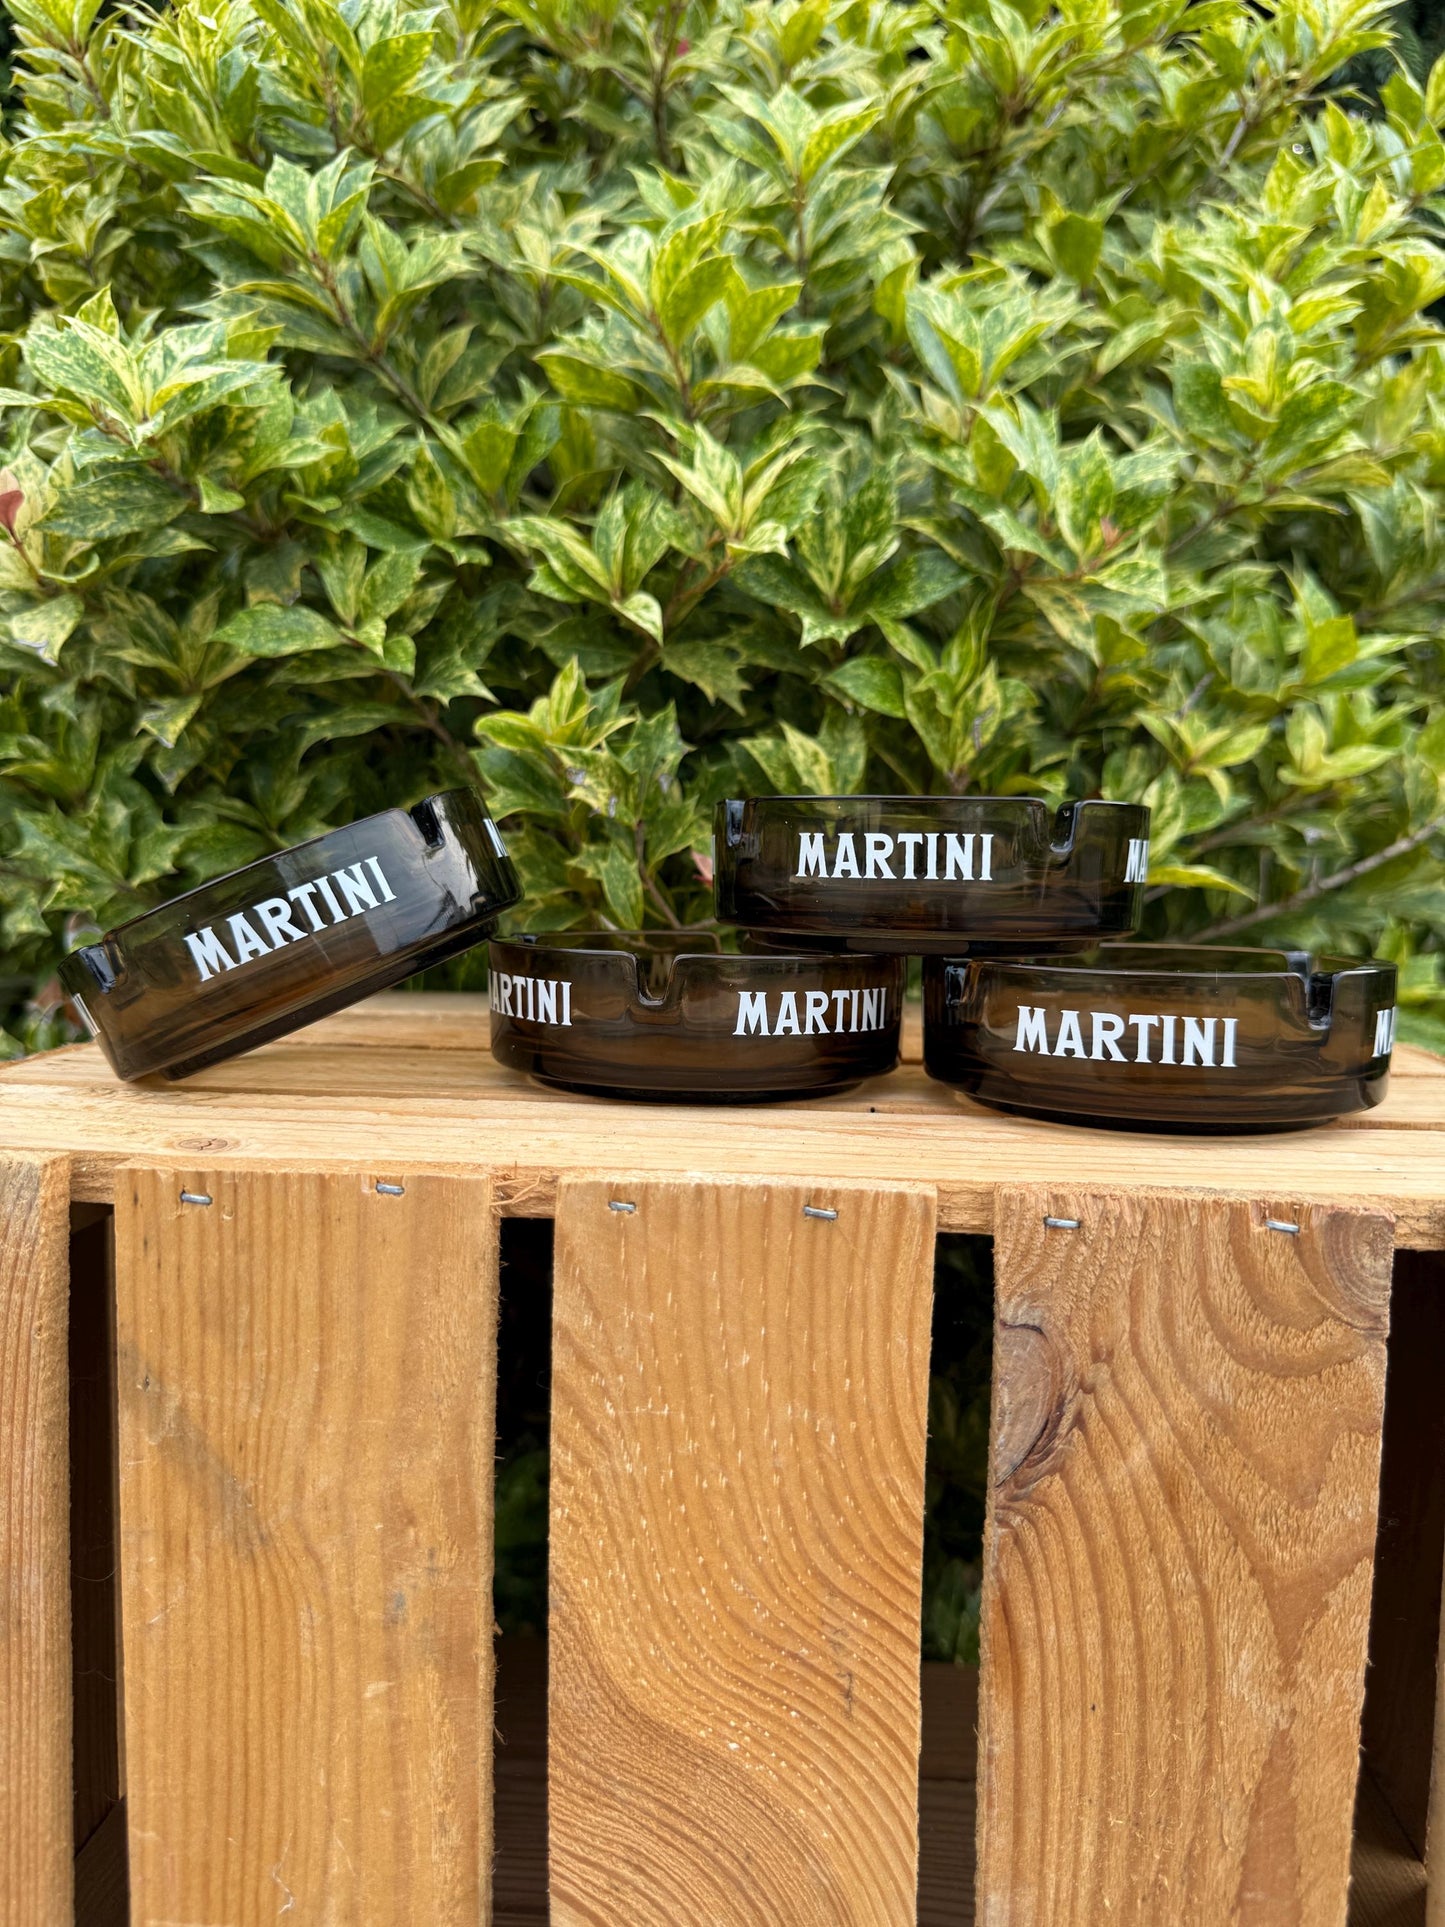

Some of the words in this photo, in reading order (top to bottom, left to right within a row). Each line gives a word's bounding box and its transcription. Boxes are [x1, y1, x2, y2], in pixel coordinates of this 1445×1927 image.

[795, 832, 995, 881] MARTINI
[183, 855, 398, 982] MARTINI
[732, 987, 887, 1036] MARTINI
[1012, 1005, 1239, 1068] MARTINI
